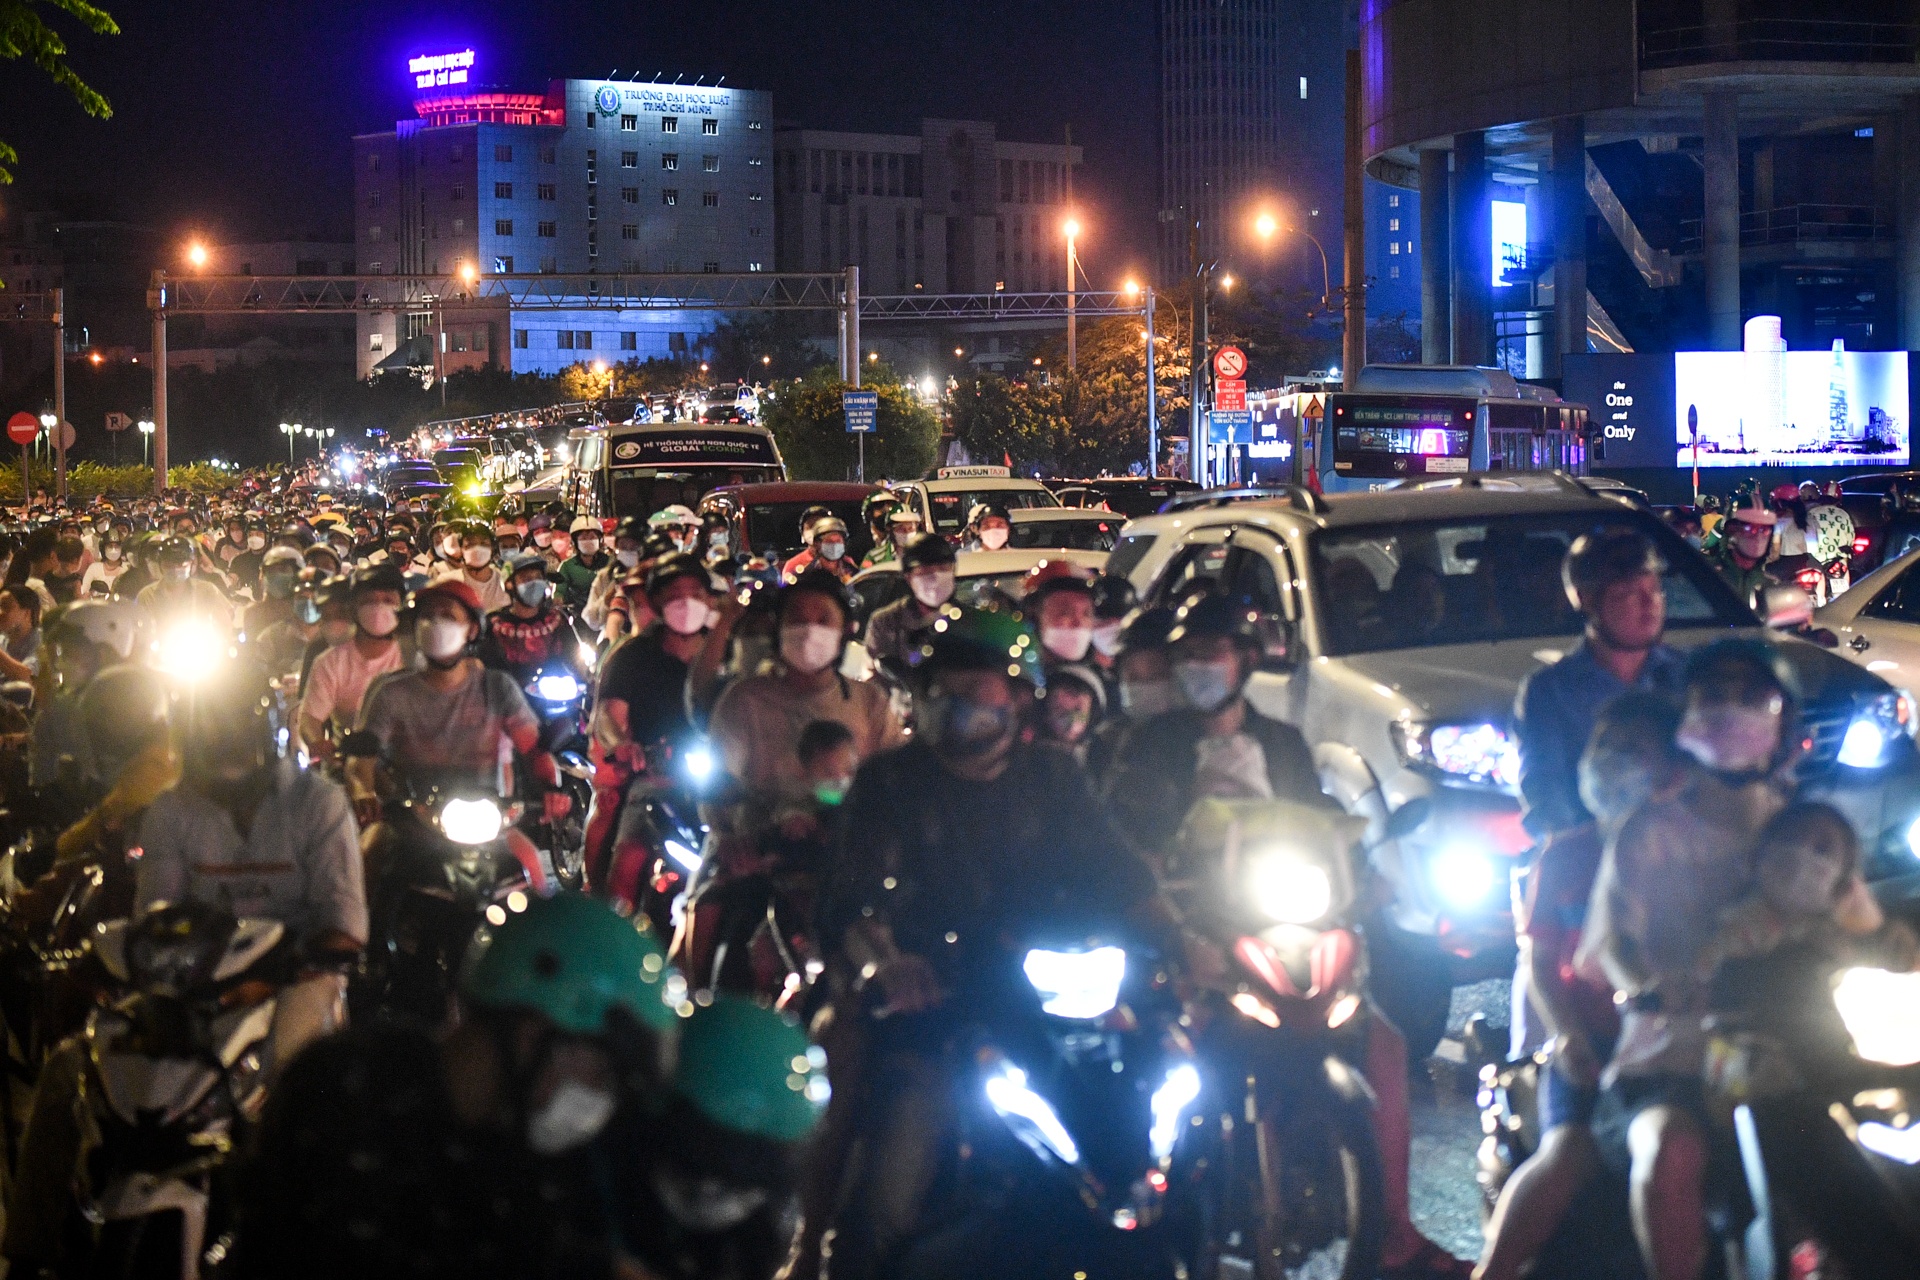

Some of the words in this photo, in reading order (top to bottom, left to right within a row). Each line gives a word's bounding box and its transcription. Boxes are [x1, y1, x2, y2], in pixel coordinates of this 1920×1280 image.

[624, 89, 663, 101] TRƯỜNG
[666, 92, 683, 103] ĐẠI
[685, 93, 706, 105] HỌC
[709, 94, 730, 106] LUẬT
[670, 102, 685, 113] CHÍ
[687, 105, 712, 114] MINH
[1613, 381, 1626, 390] the
[1605, 393, 1633, 406] One
[1612, 411, 1628, 420] and
[1604, 424, 1636, 441] Only
[703, 446, 745, 454] ECOKIDS
[953, 468, 989, 476] VINASUN
